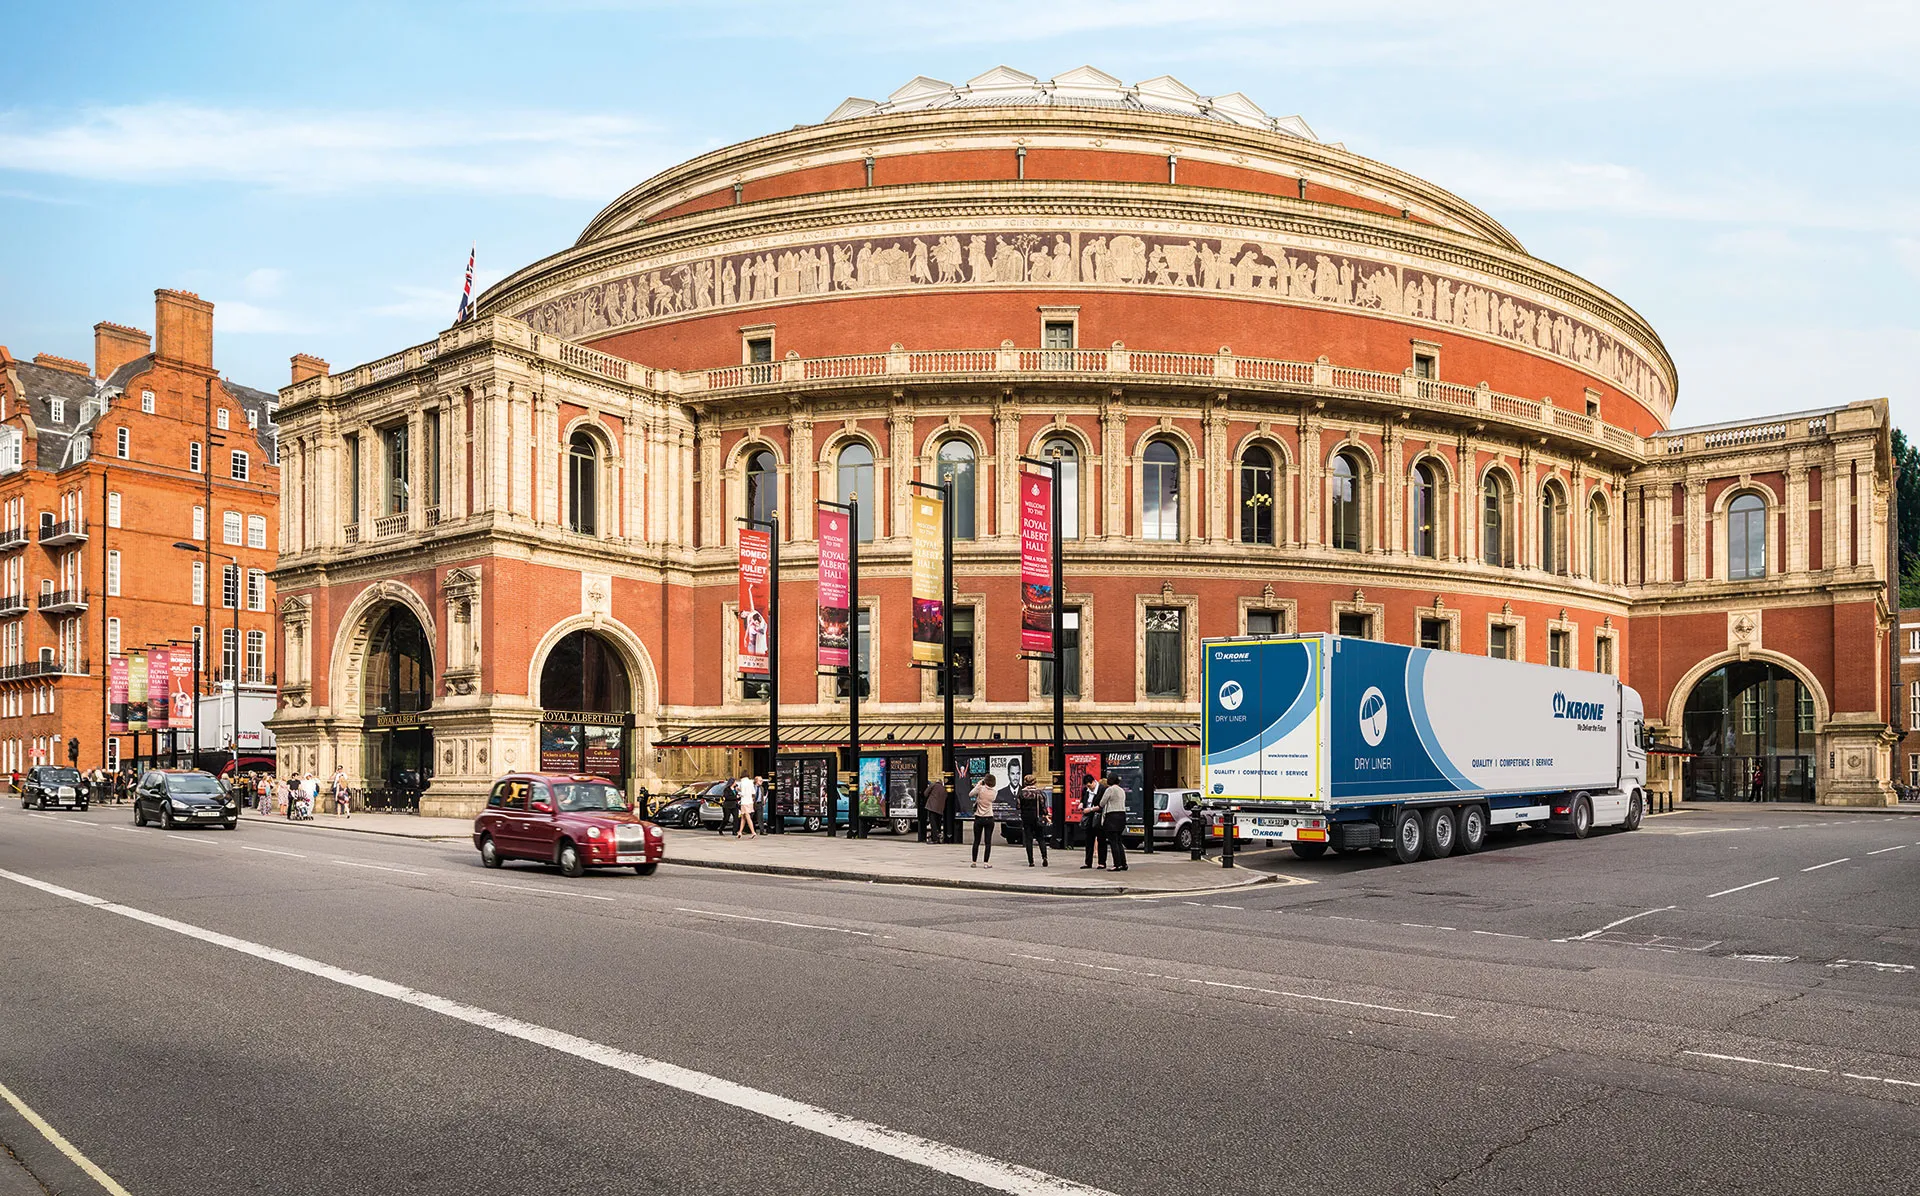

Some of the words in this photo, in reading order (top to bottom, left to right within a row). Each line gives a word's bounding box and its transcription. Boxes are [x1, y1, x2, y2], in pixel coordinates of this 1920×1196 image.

[784, 228, 850, 243] ADVANCEMENT
[928, 220, 951, 229] ARTS
[968, 219, 988, 228] AND
[1004, 218, 1050, 227] SCIENCES
[1070, 219, 1090, 228] AND
[1111, 221, 1145, 230] WORKS
[1201, 225, 1246, 238] INDUSTRY
[1025, 500, 1046, 510] WELCOME
[1024, 518, 1047, 531] ROYAL
[1022, 529, 1048, 542] ALBERT
[916, 538, 937, 550] ROYAL
[1026, 540, 1045, 552] HALL
[740, 549, 767, 560] ROMEO
[822, 550, 845, 561] ROYAL
[914, 548, 939, 560] ALBERT
[740, 564, 767, 574] JULIET
[820, 560, 847, 570] ALBERT
[917, 559, 936, 570] HALL
[824, 570, 843, 580] HALL
[1566, 701, 1604, 720] KRONE
[543, 712, 570, 720] ROYAL
[571, 714, 604, 722] ALBERT
[604, 715, 624, 724] HALL
[1355, 758, 1370, 770] DRY
[1372, 758, 1392, 770] LINER
[1472, 759, 1493, 767] QUALITY
[1500, 759, 1530, 767] COMPETENCE
